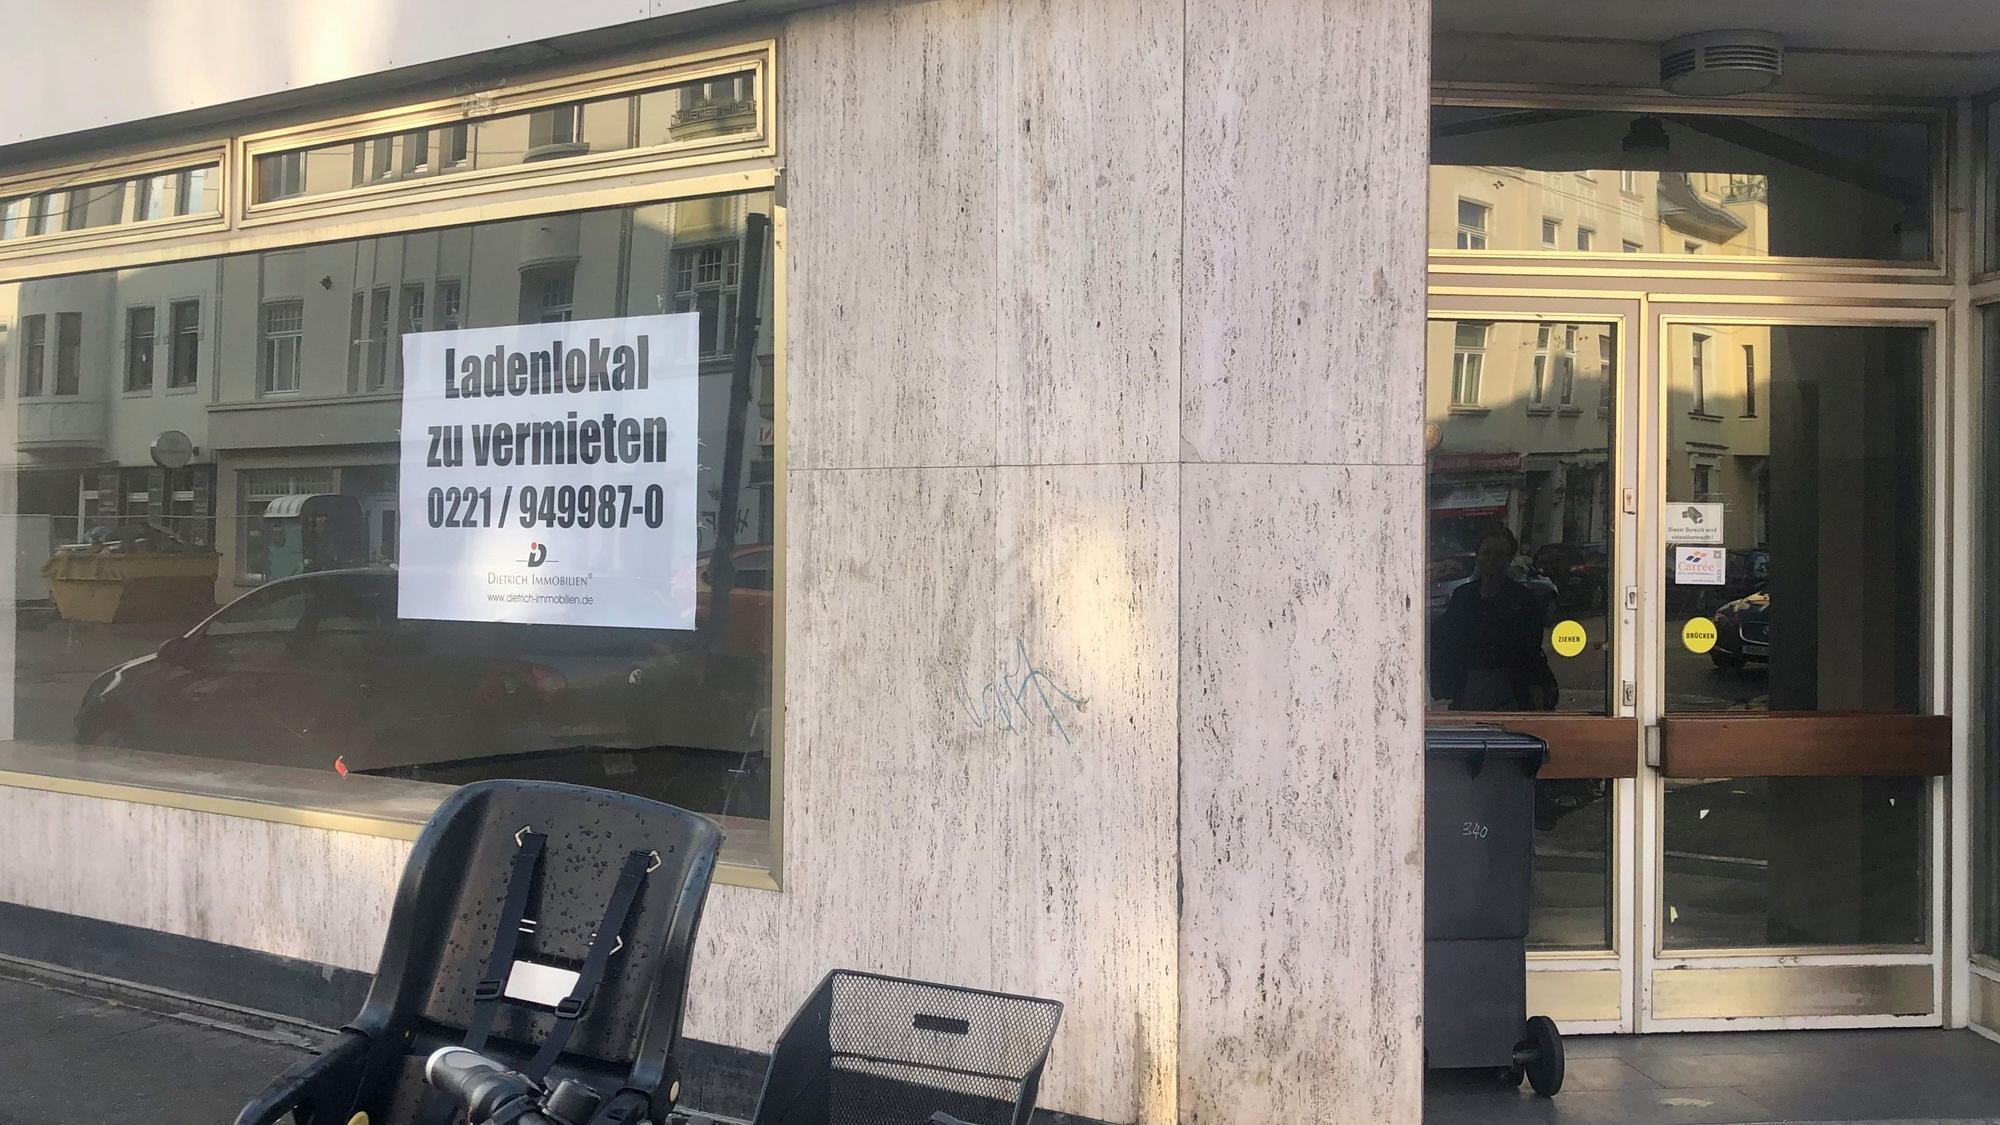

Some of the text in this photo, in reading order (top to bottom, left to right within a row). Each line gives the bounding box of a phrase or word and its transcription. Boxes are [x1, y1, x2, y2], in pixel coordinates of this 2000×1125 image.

[445, 335, 649, 399] Ladenlokal
[426, 411, 667, 467] zu vermieten
[427, 486, 491, 528] 0221
[519, 484, 664, 529] 949987-0
[487, 593, 594, 606] www.dietrich-immobilien.de
[1686, 632, 1715, 640] DRÜCKEN
[1462, 821, 1489, 840] 340
